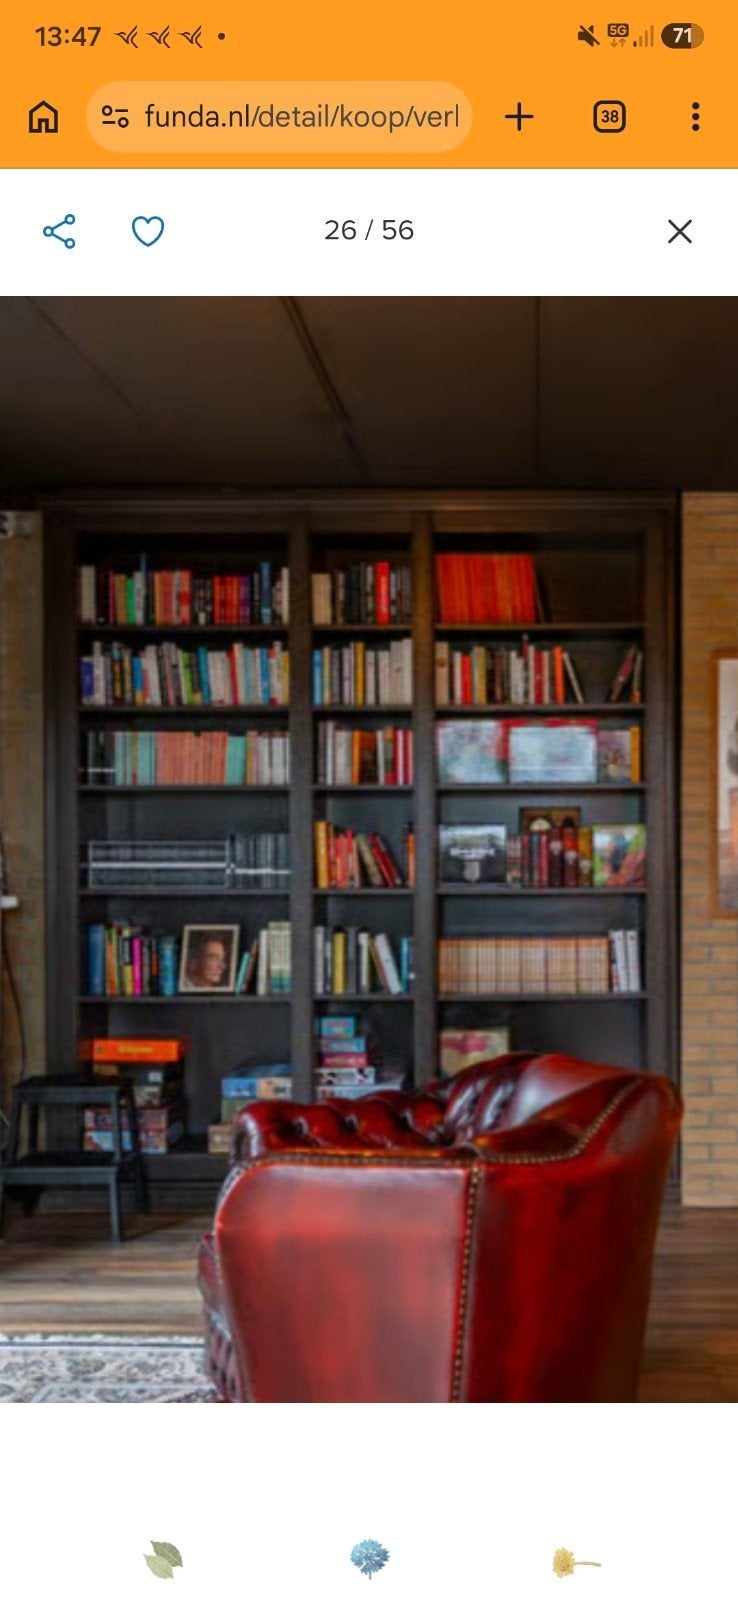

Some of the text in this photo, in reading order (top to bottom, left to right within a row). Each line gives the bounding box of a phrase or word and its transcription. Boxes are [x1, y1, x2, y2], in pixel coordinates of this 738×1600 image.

[35, 26, 101, 47] 13:47
[609, 25, 627, 36] 5G
[673, 27, 692, 43] 71
[601, 109, 619, 123] 38
[324, 218, 415, 241] 26 / 56
